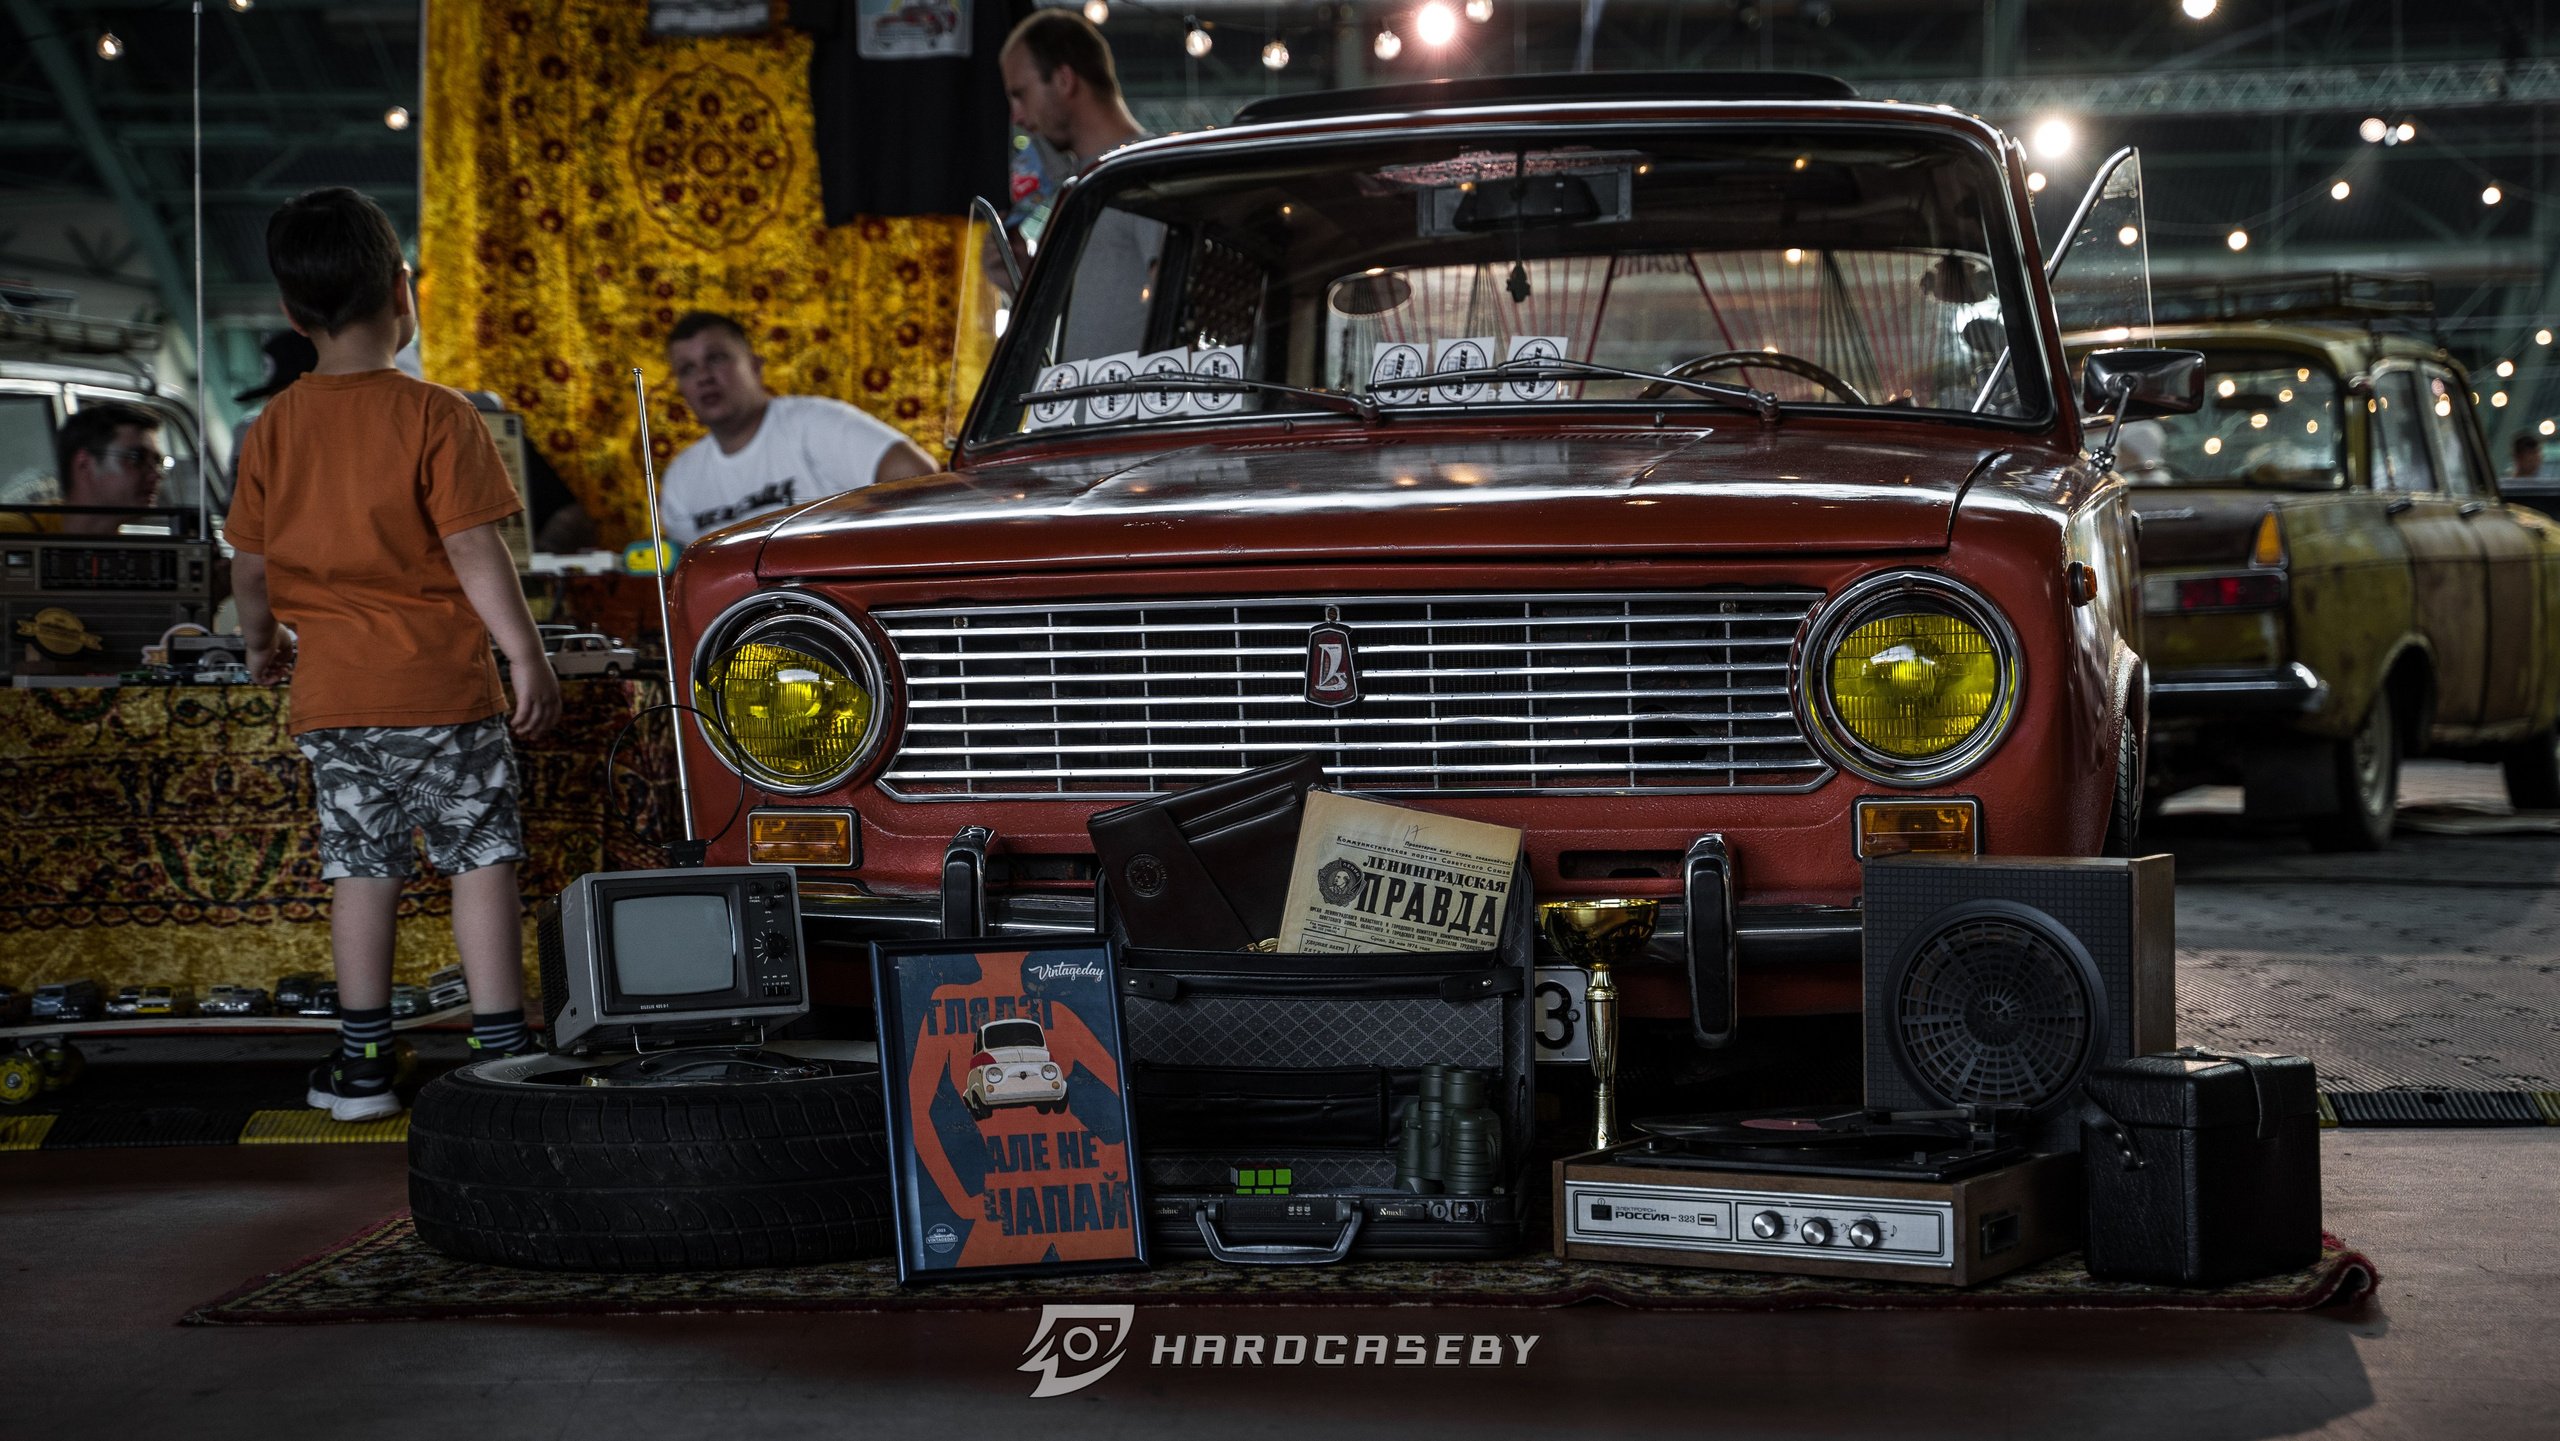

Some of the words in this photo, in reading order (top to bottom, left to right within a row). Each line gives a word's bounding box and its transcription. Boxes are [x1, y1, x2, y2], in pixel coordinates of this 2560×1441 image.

[1336, 835, 1407, 856] Коммунистическая
[1411, 852, 1437, 862] партия
[1441, 857, 1483, 871] Советского
[1487, 866, 1510, 876] Союза
[1404, 840, 1437, 852] Пролетарии
[1362, 855, 1508, 894] ЛЕНИНГРАДСКАЯ
[1354, 871, 1499, 937] ПРАВДА
[1028, 961, 1105, 982] Vintageday
[985, 1132, 1051, 1174] АЛЕ
[1056, 1129, 1100, 1170] НЕ
[983, 1170, 1129, 1237] ЧАПАЙ
[1615, 1205, 1657, 1213] ЭЛЕКТРОФОН
